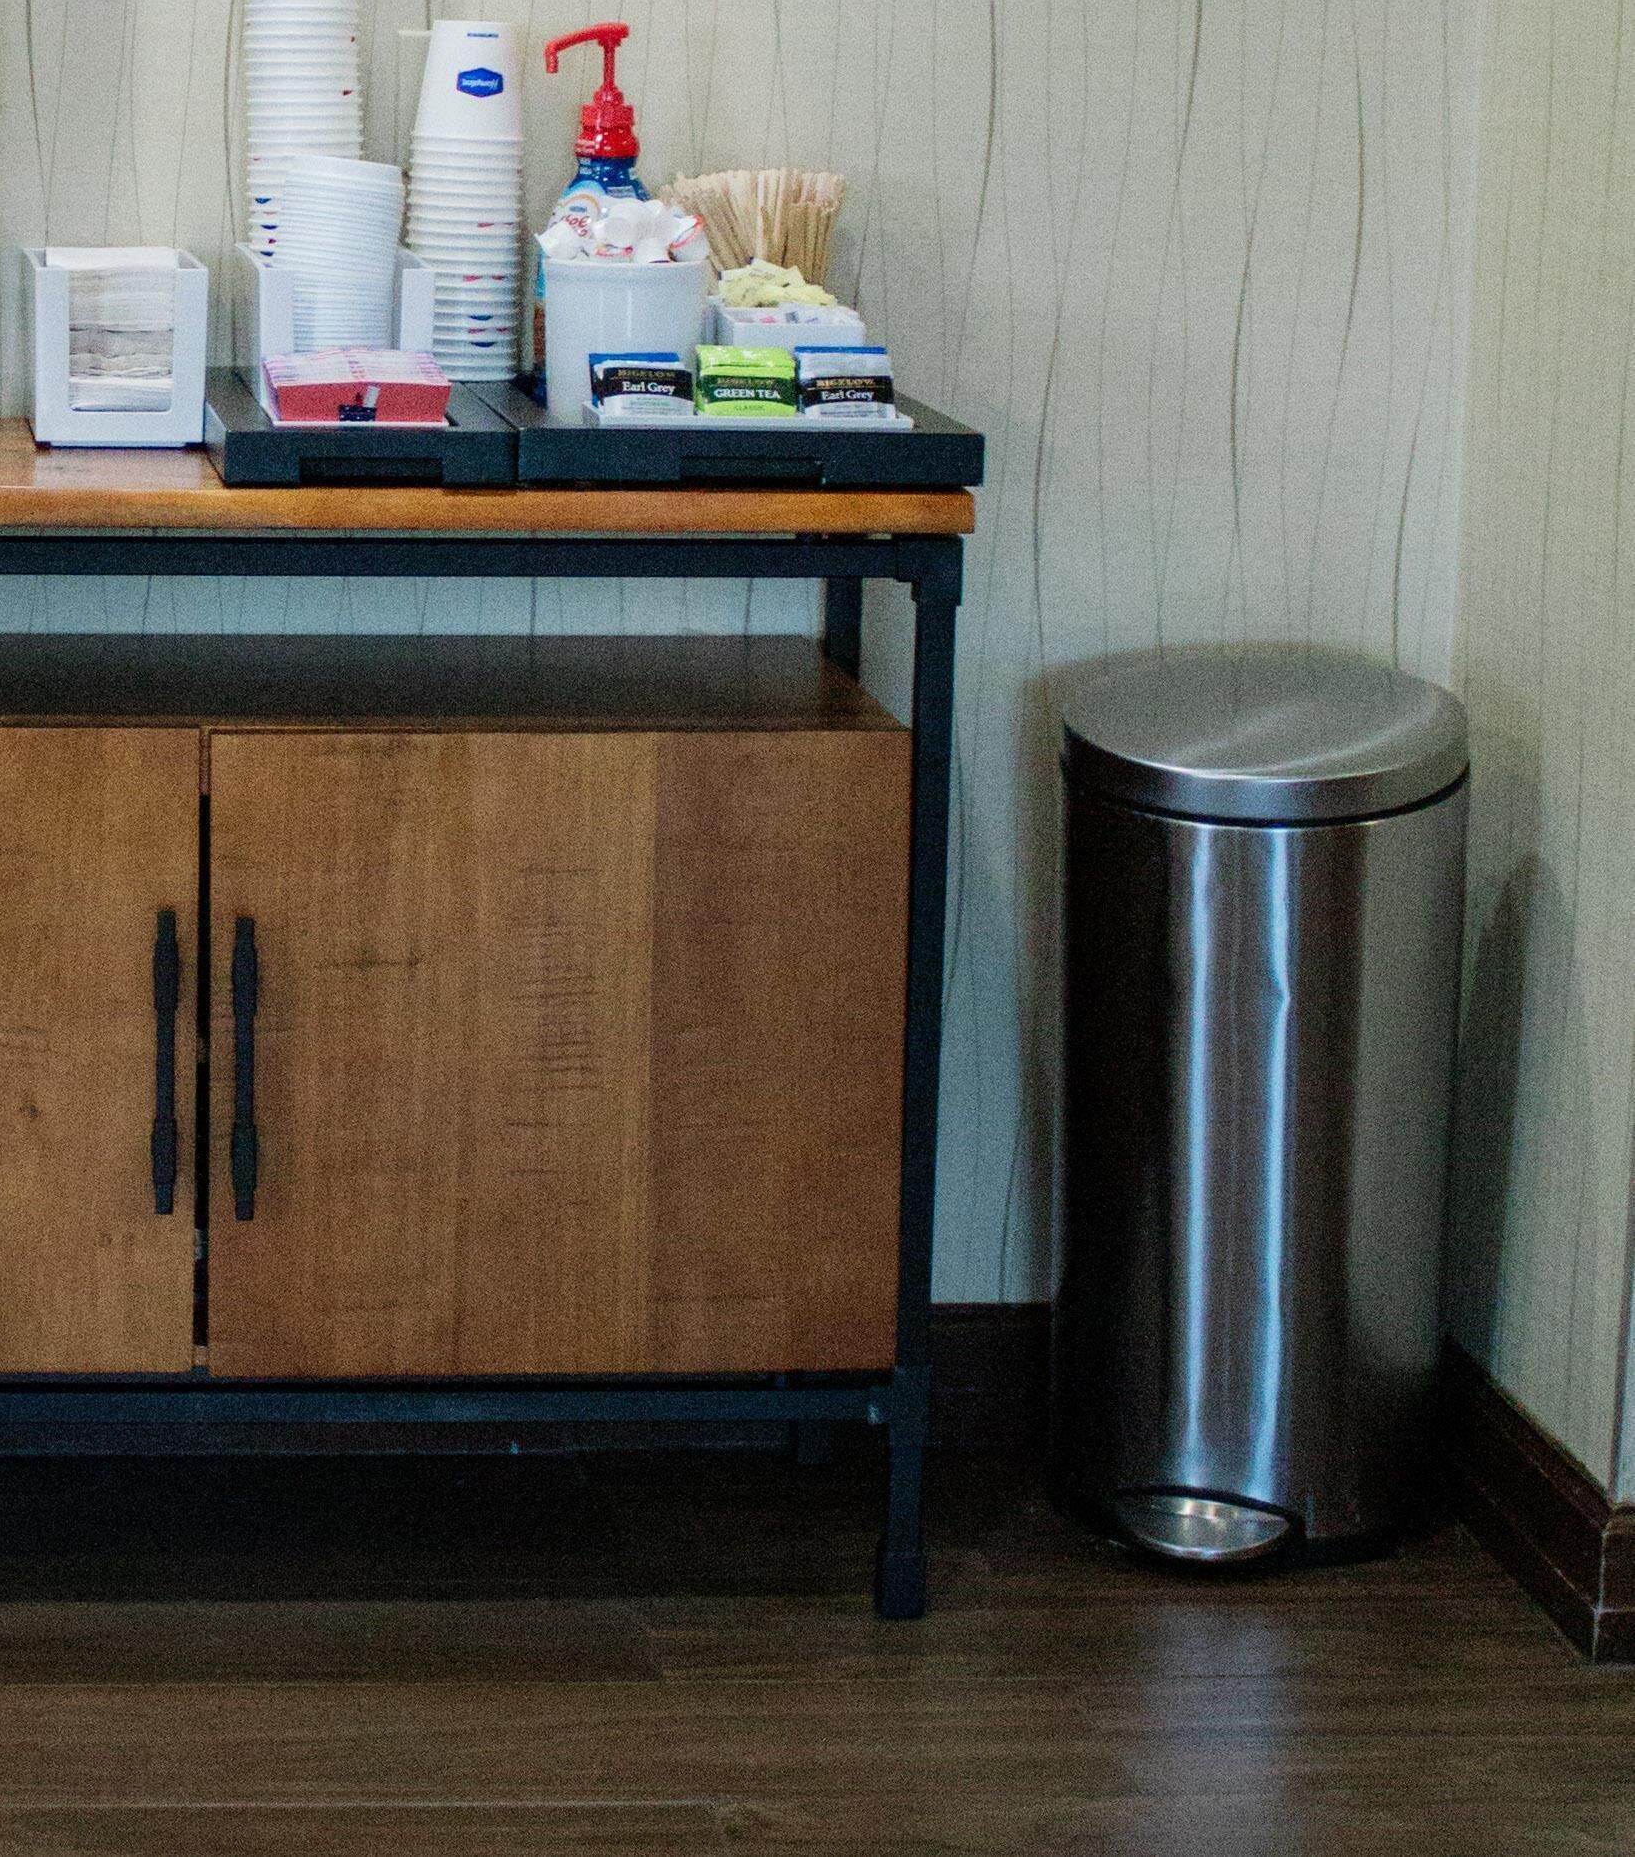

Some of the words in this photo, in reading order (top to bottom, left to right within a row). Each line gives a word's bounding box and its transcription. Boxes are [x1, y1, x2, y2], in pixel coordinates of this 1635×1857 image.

[622, 382, 646, 392] Earl
[648, 383, 676, 395] Grey
[714, 388, 755, 398] GREEN
[757, 389, 781, 399] TEA
[821, 389, 845, 400] Earl
[846, 389, 874, 400] Grey
